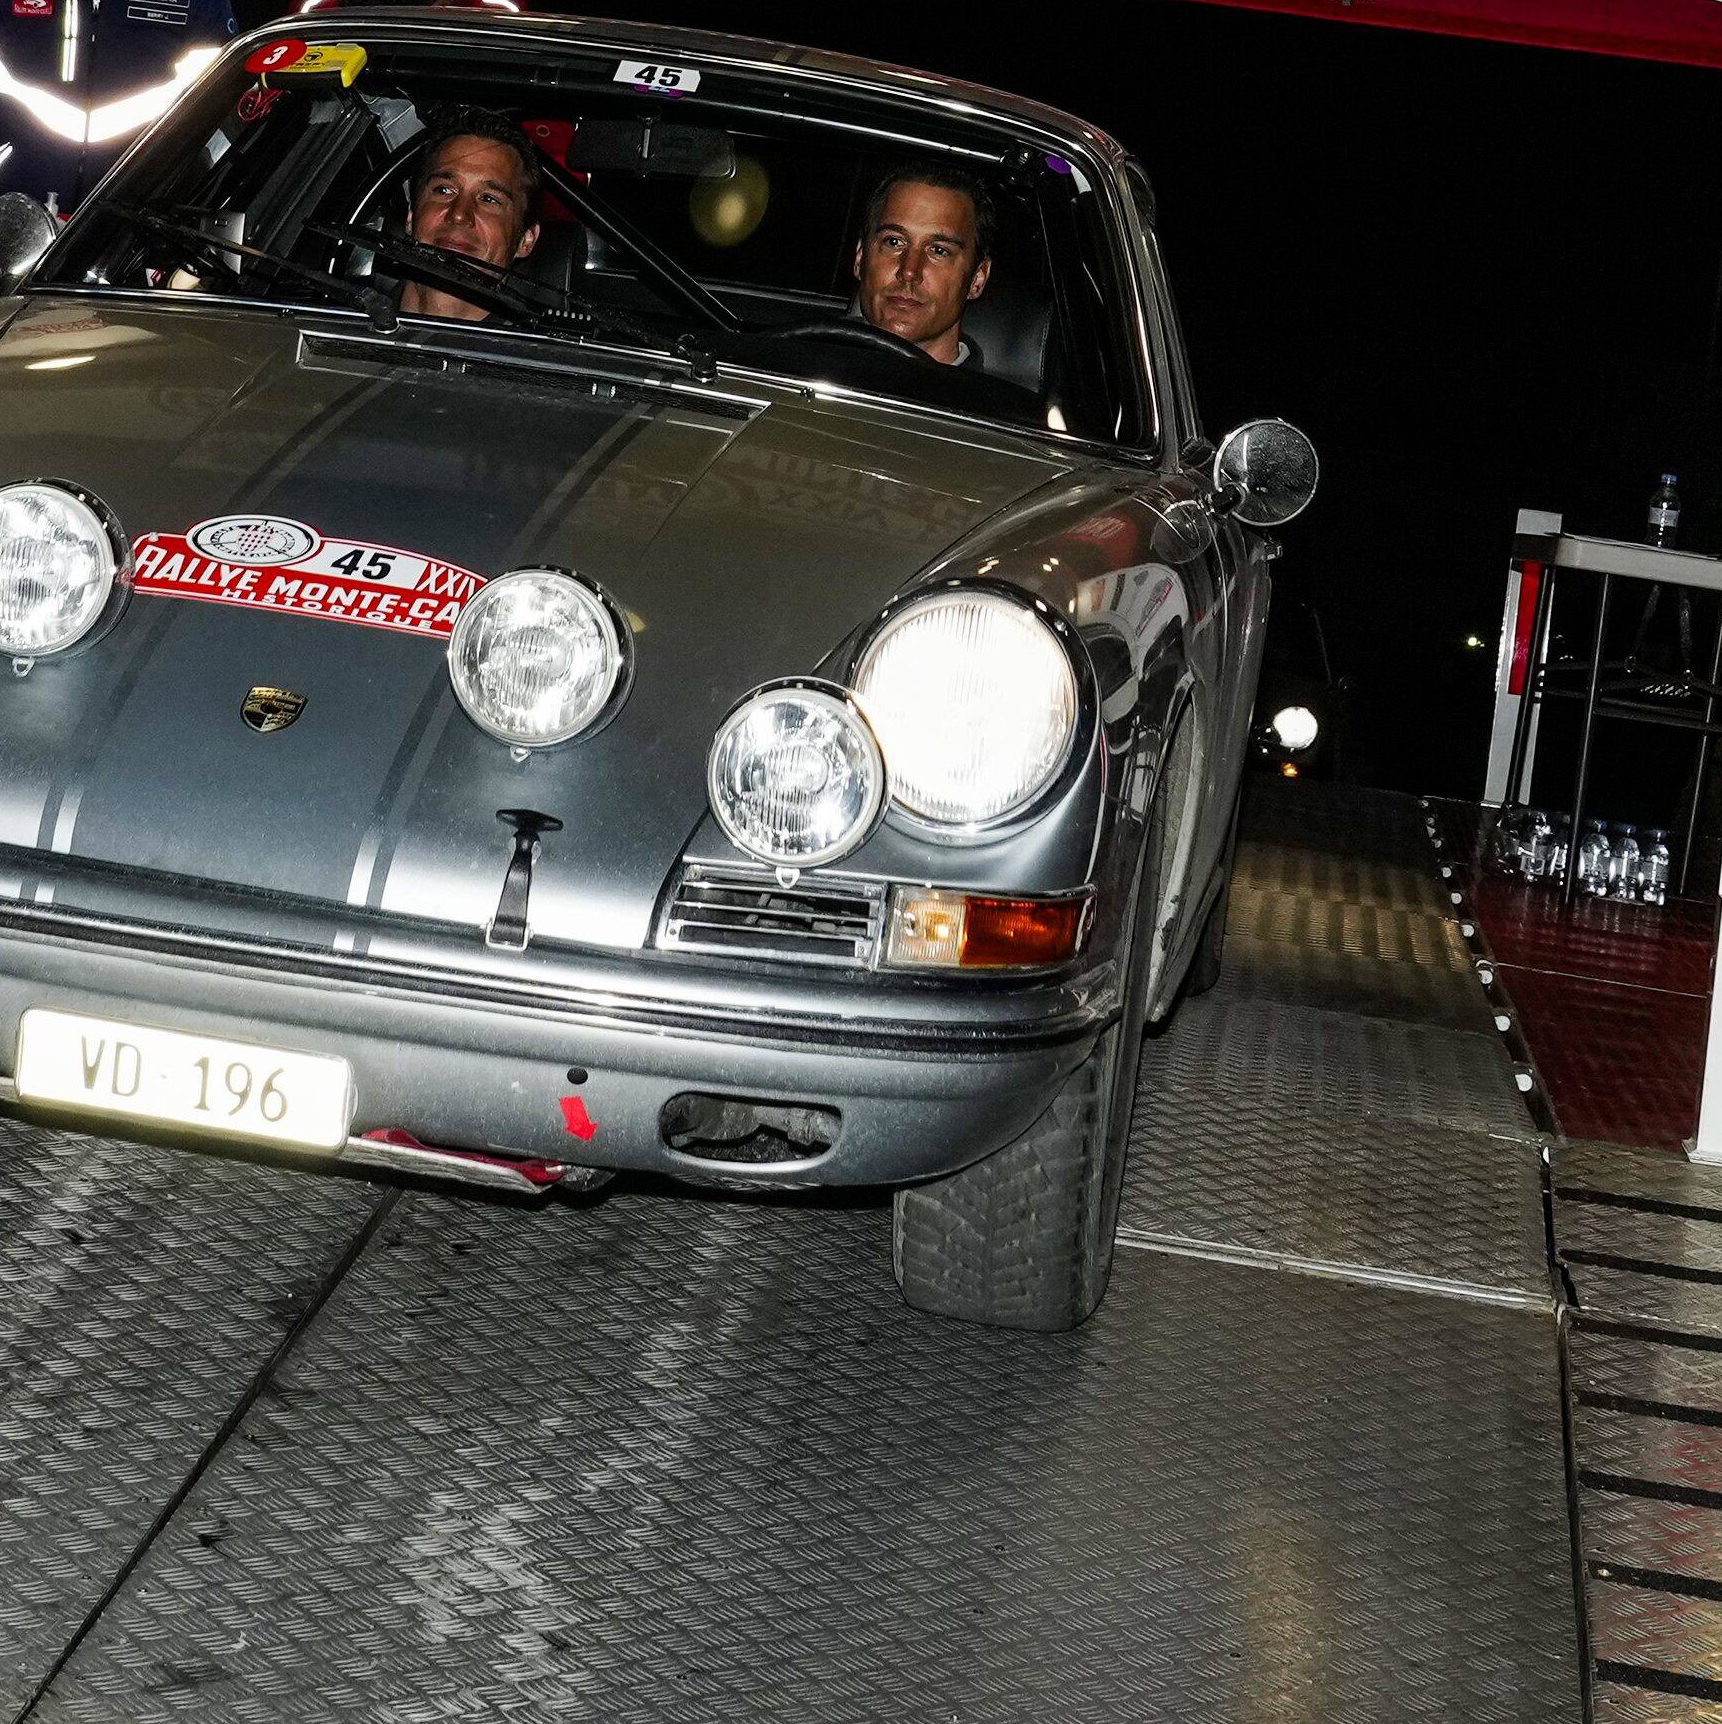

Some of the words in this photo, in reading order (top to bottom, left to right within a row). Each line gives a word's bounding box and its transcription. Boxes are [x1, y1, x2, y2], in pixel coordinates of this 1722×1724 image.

[262, 45, 289, 65] 3
[634, 65, 683, 87] 45
[330, 548, 396, 581] 45
[135, 543, 263, 591] RALLYE
[268, 575, 461, 625] MONTE-CA
[221, 588, 434, 629] HISTORIQUE
[80, 1035, 143, 1098] VD
[193, 1056, 289, 1123] 196
